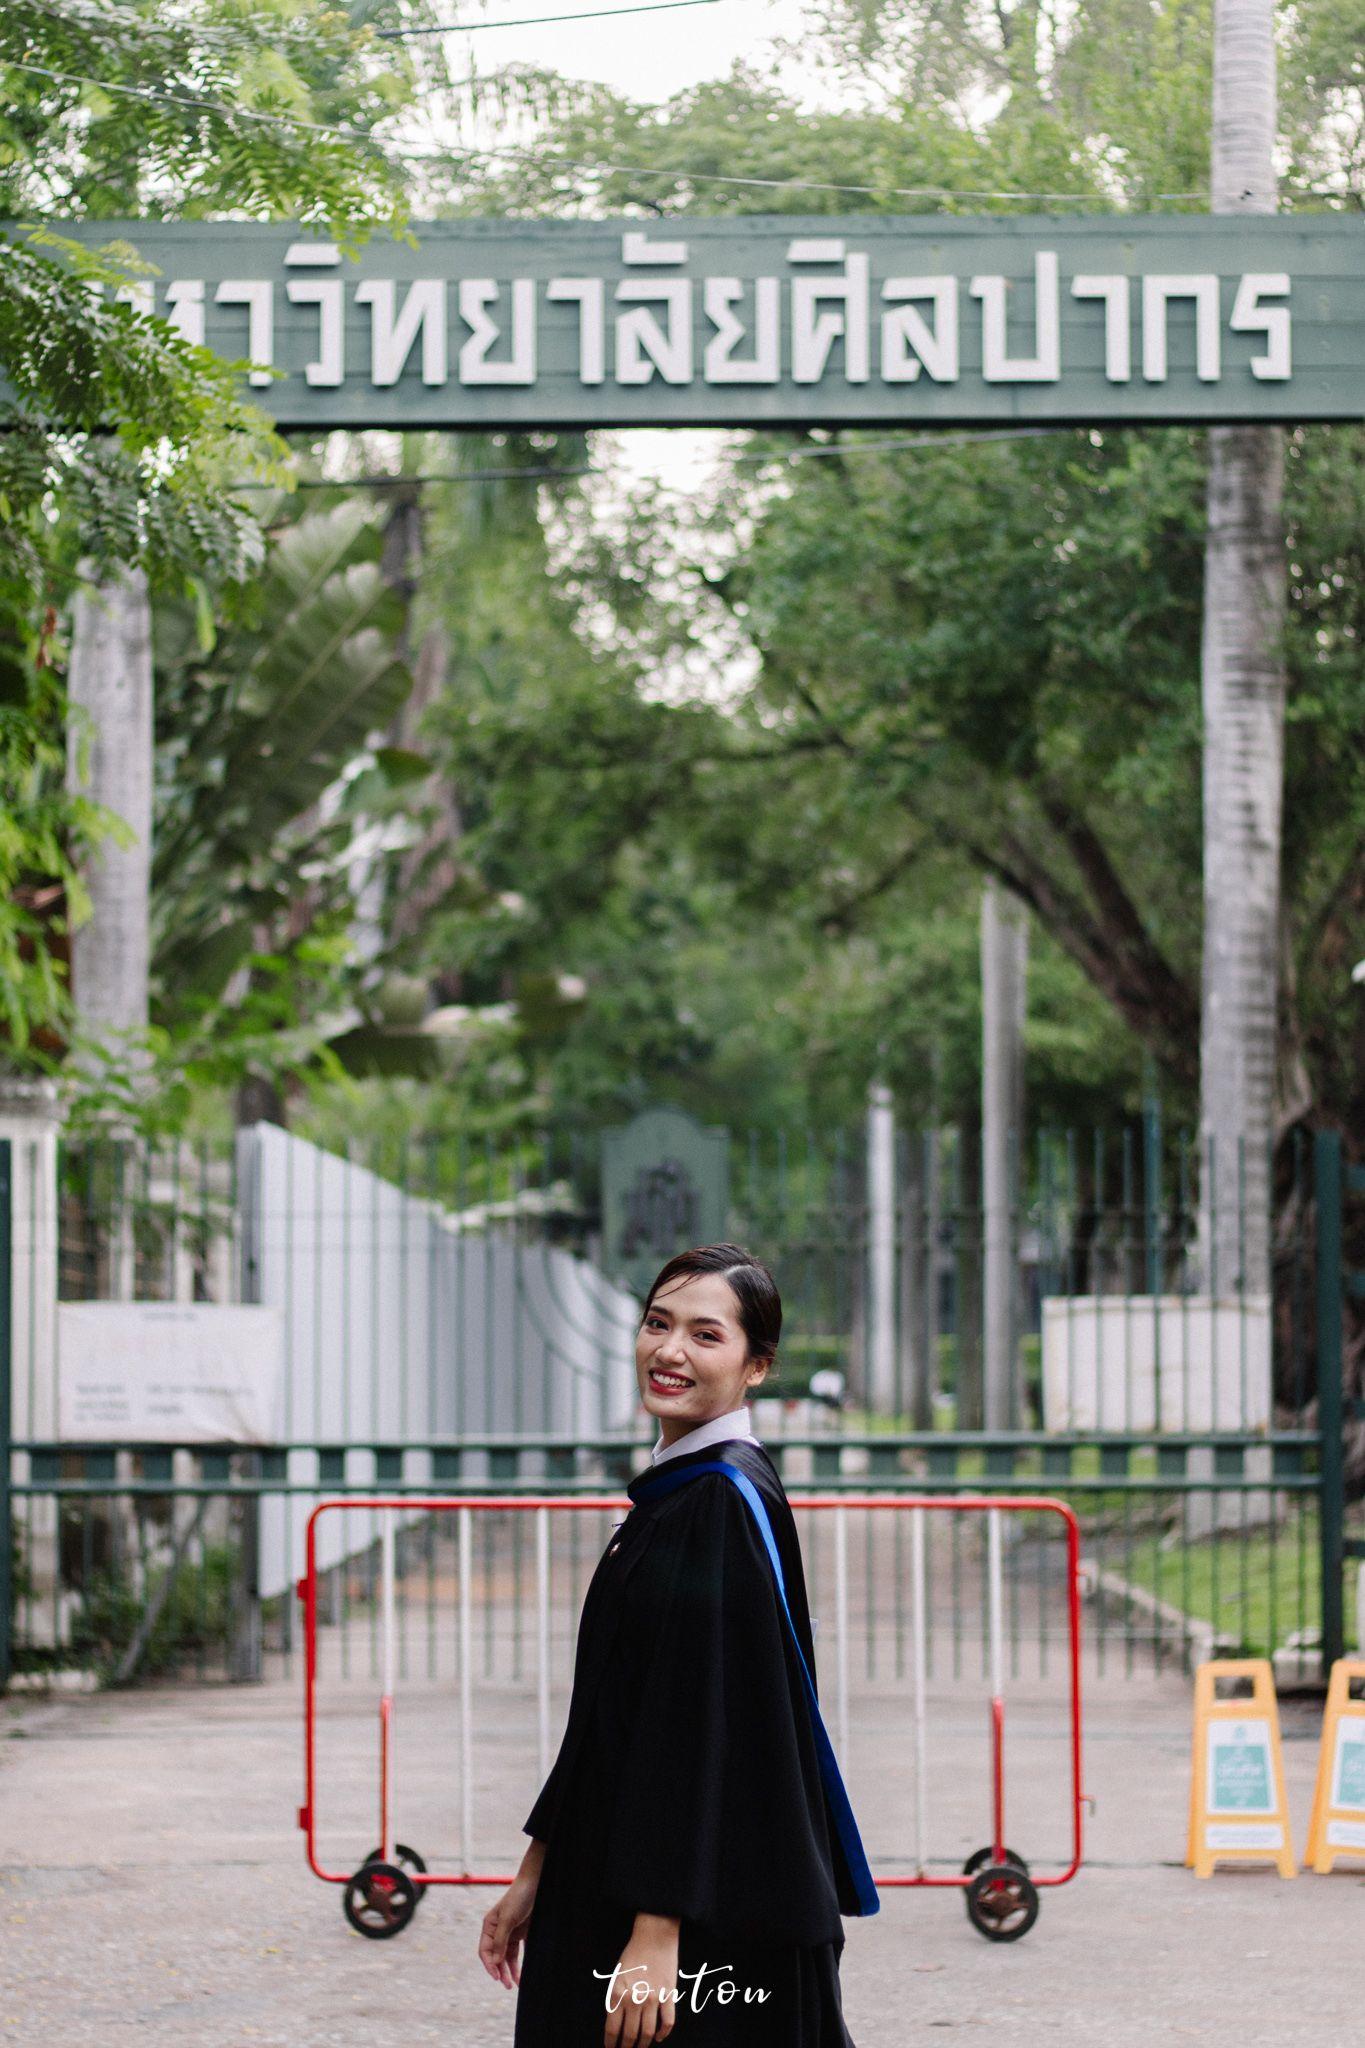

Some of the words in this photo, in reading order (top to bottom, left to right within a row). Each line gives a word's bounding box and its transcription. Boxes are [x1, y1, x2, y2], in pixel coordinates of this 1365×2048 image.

[82, 231, 1292, 386] หาวิทยาลัยศิลปากร
